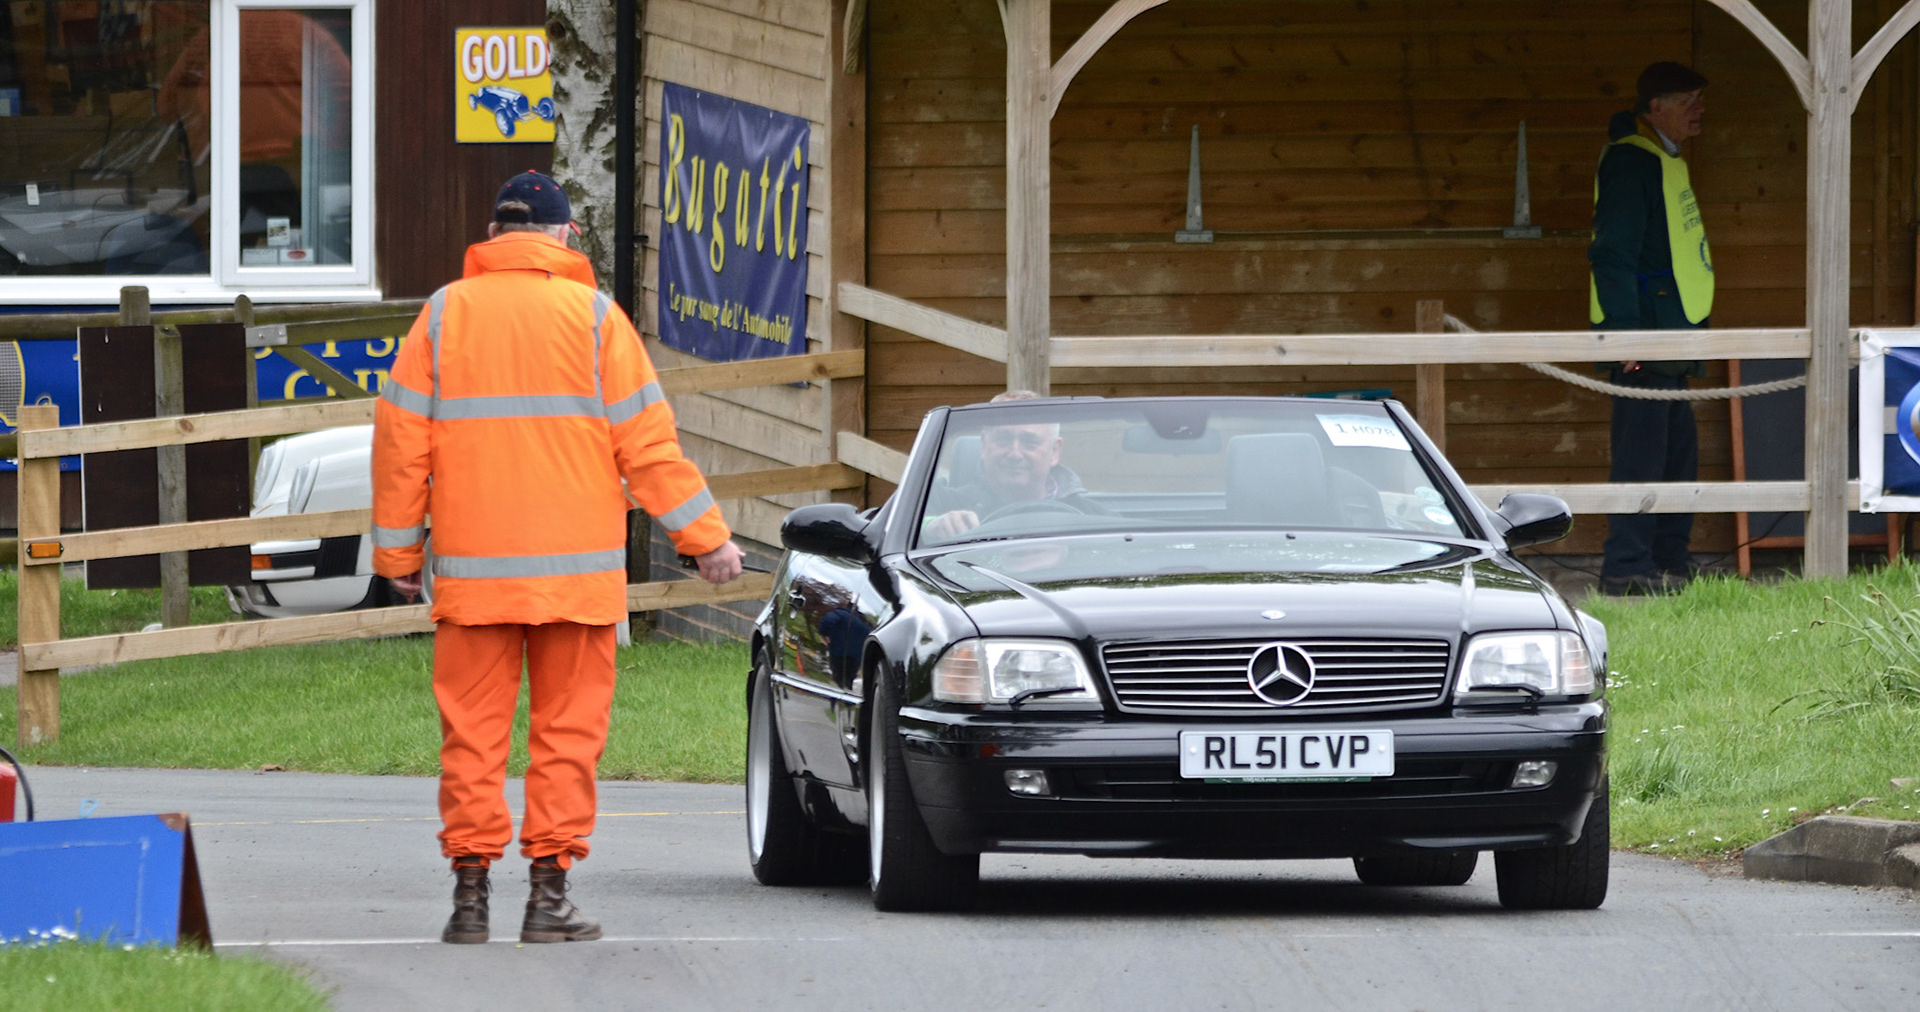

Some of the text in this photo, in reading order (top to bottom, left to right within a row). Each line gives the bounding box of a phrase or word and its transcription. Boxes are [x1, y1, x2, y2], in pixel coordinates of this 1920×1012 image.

[461, 33, 550, 84] GOLD
[664, 113, 803, 273] Bugatti
[669, 282, 681, 313] Le
[680, 295, 698, 323] pur
[720, 299, 734, 329] de
[1204, 734, 1371, 770] RL51 CVP
